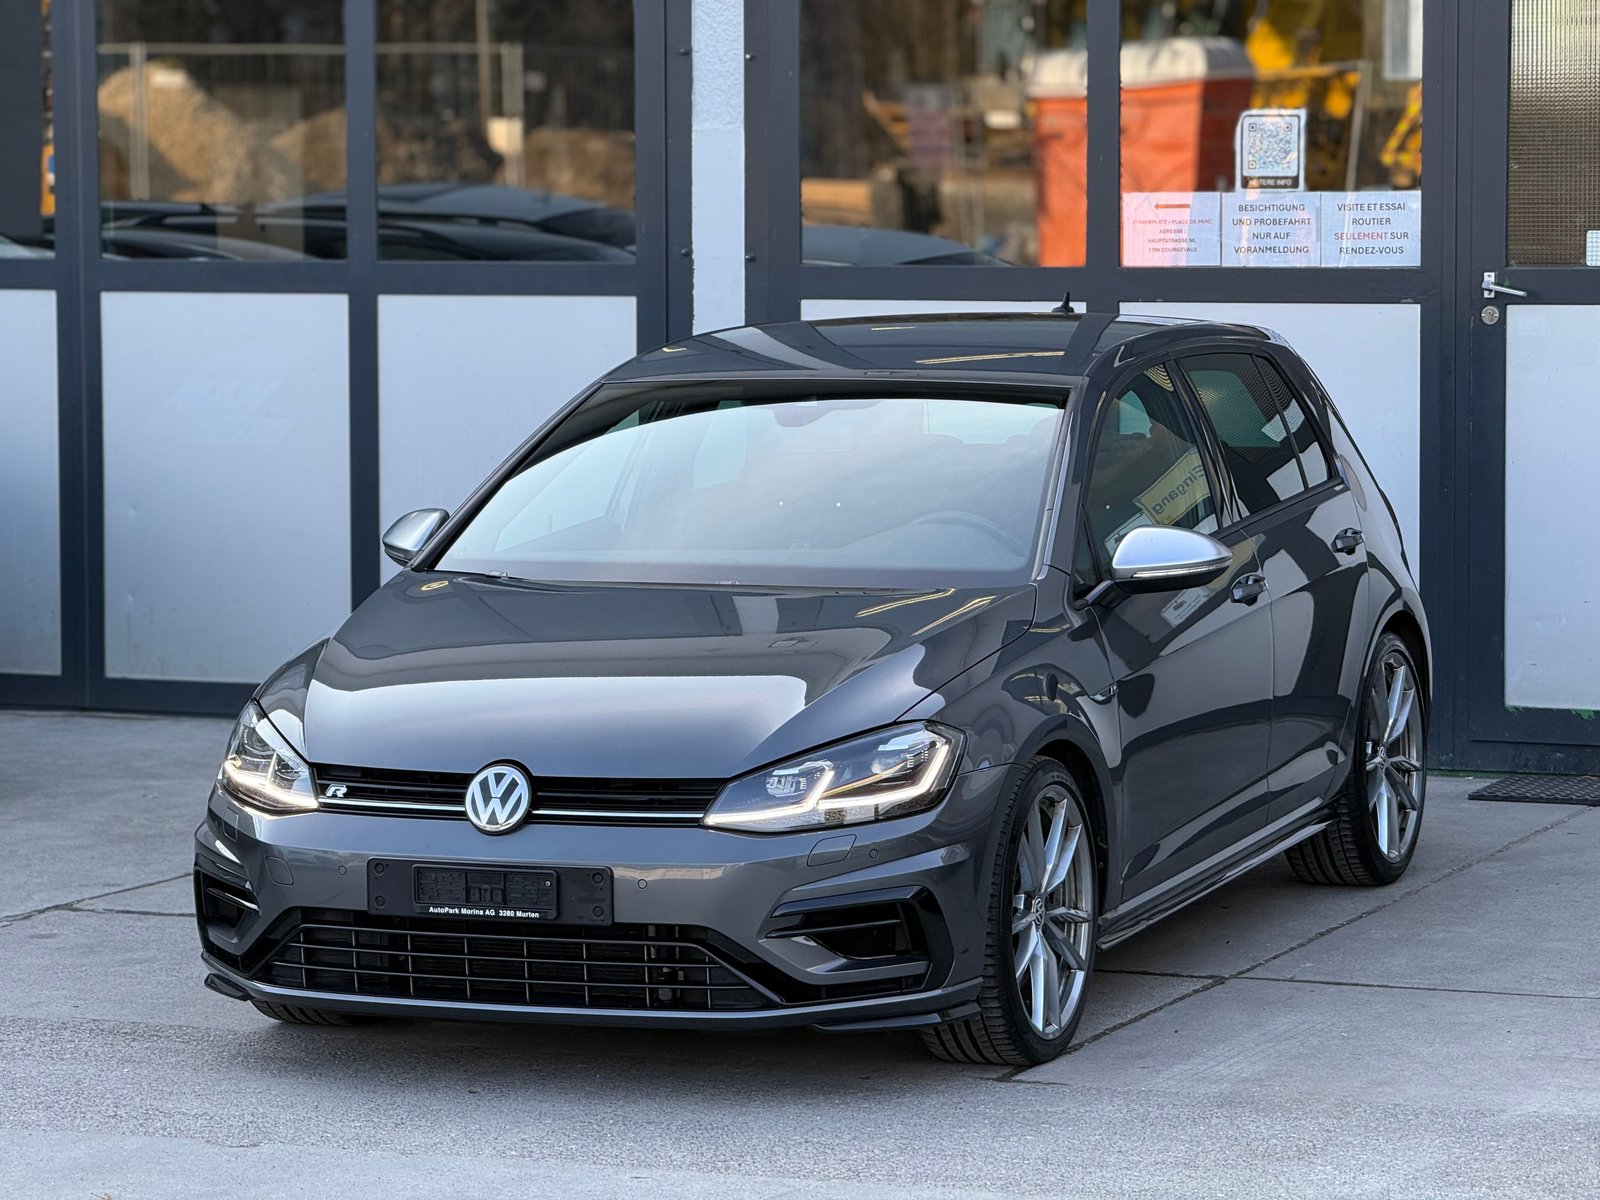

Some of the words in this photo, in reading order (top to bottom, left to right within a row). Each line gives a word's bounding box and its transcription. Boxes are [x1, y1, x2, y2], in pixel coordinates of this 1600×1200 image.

[1238, 203, 1305, 212] BESICHTIGUNG
[1337, 203, 1365, 212] VISITE
[1367, 203, 1378, 211] ET
[1379, 202, 1406, 211] ESSAI
[1232, 218, 1252, 226] UND
[1254, 218, 1312, 226] PROBEFAHRT
[1352, 217, 1392, 226] ROUTIER
[1252, 232, 1272, 240] NUR
[1273, 232, 1291, 240] AUF
[1334, 232, 1388, 241] SEULEMENT
[1390, 232, 1409, 240] SUR
[1234, 246, 1309, 254] VORANMELDUNG
[1339, 246, 1404, 255] RENDEZ-VOUS
[324, 783, 348, 798] R
[429, 906, 460, 914] AutoPark
[461, 908, 484, 916] Morina
